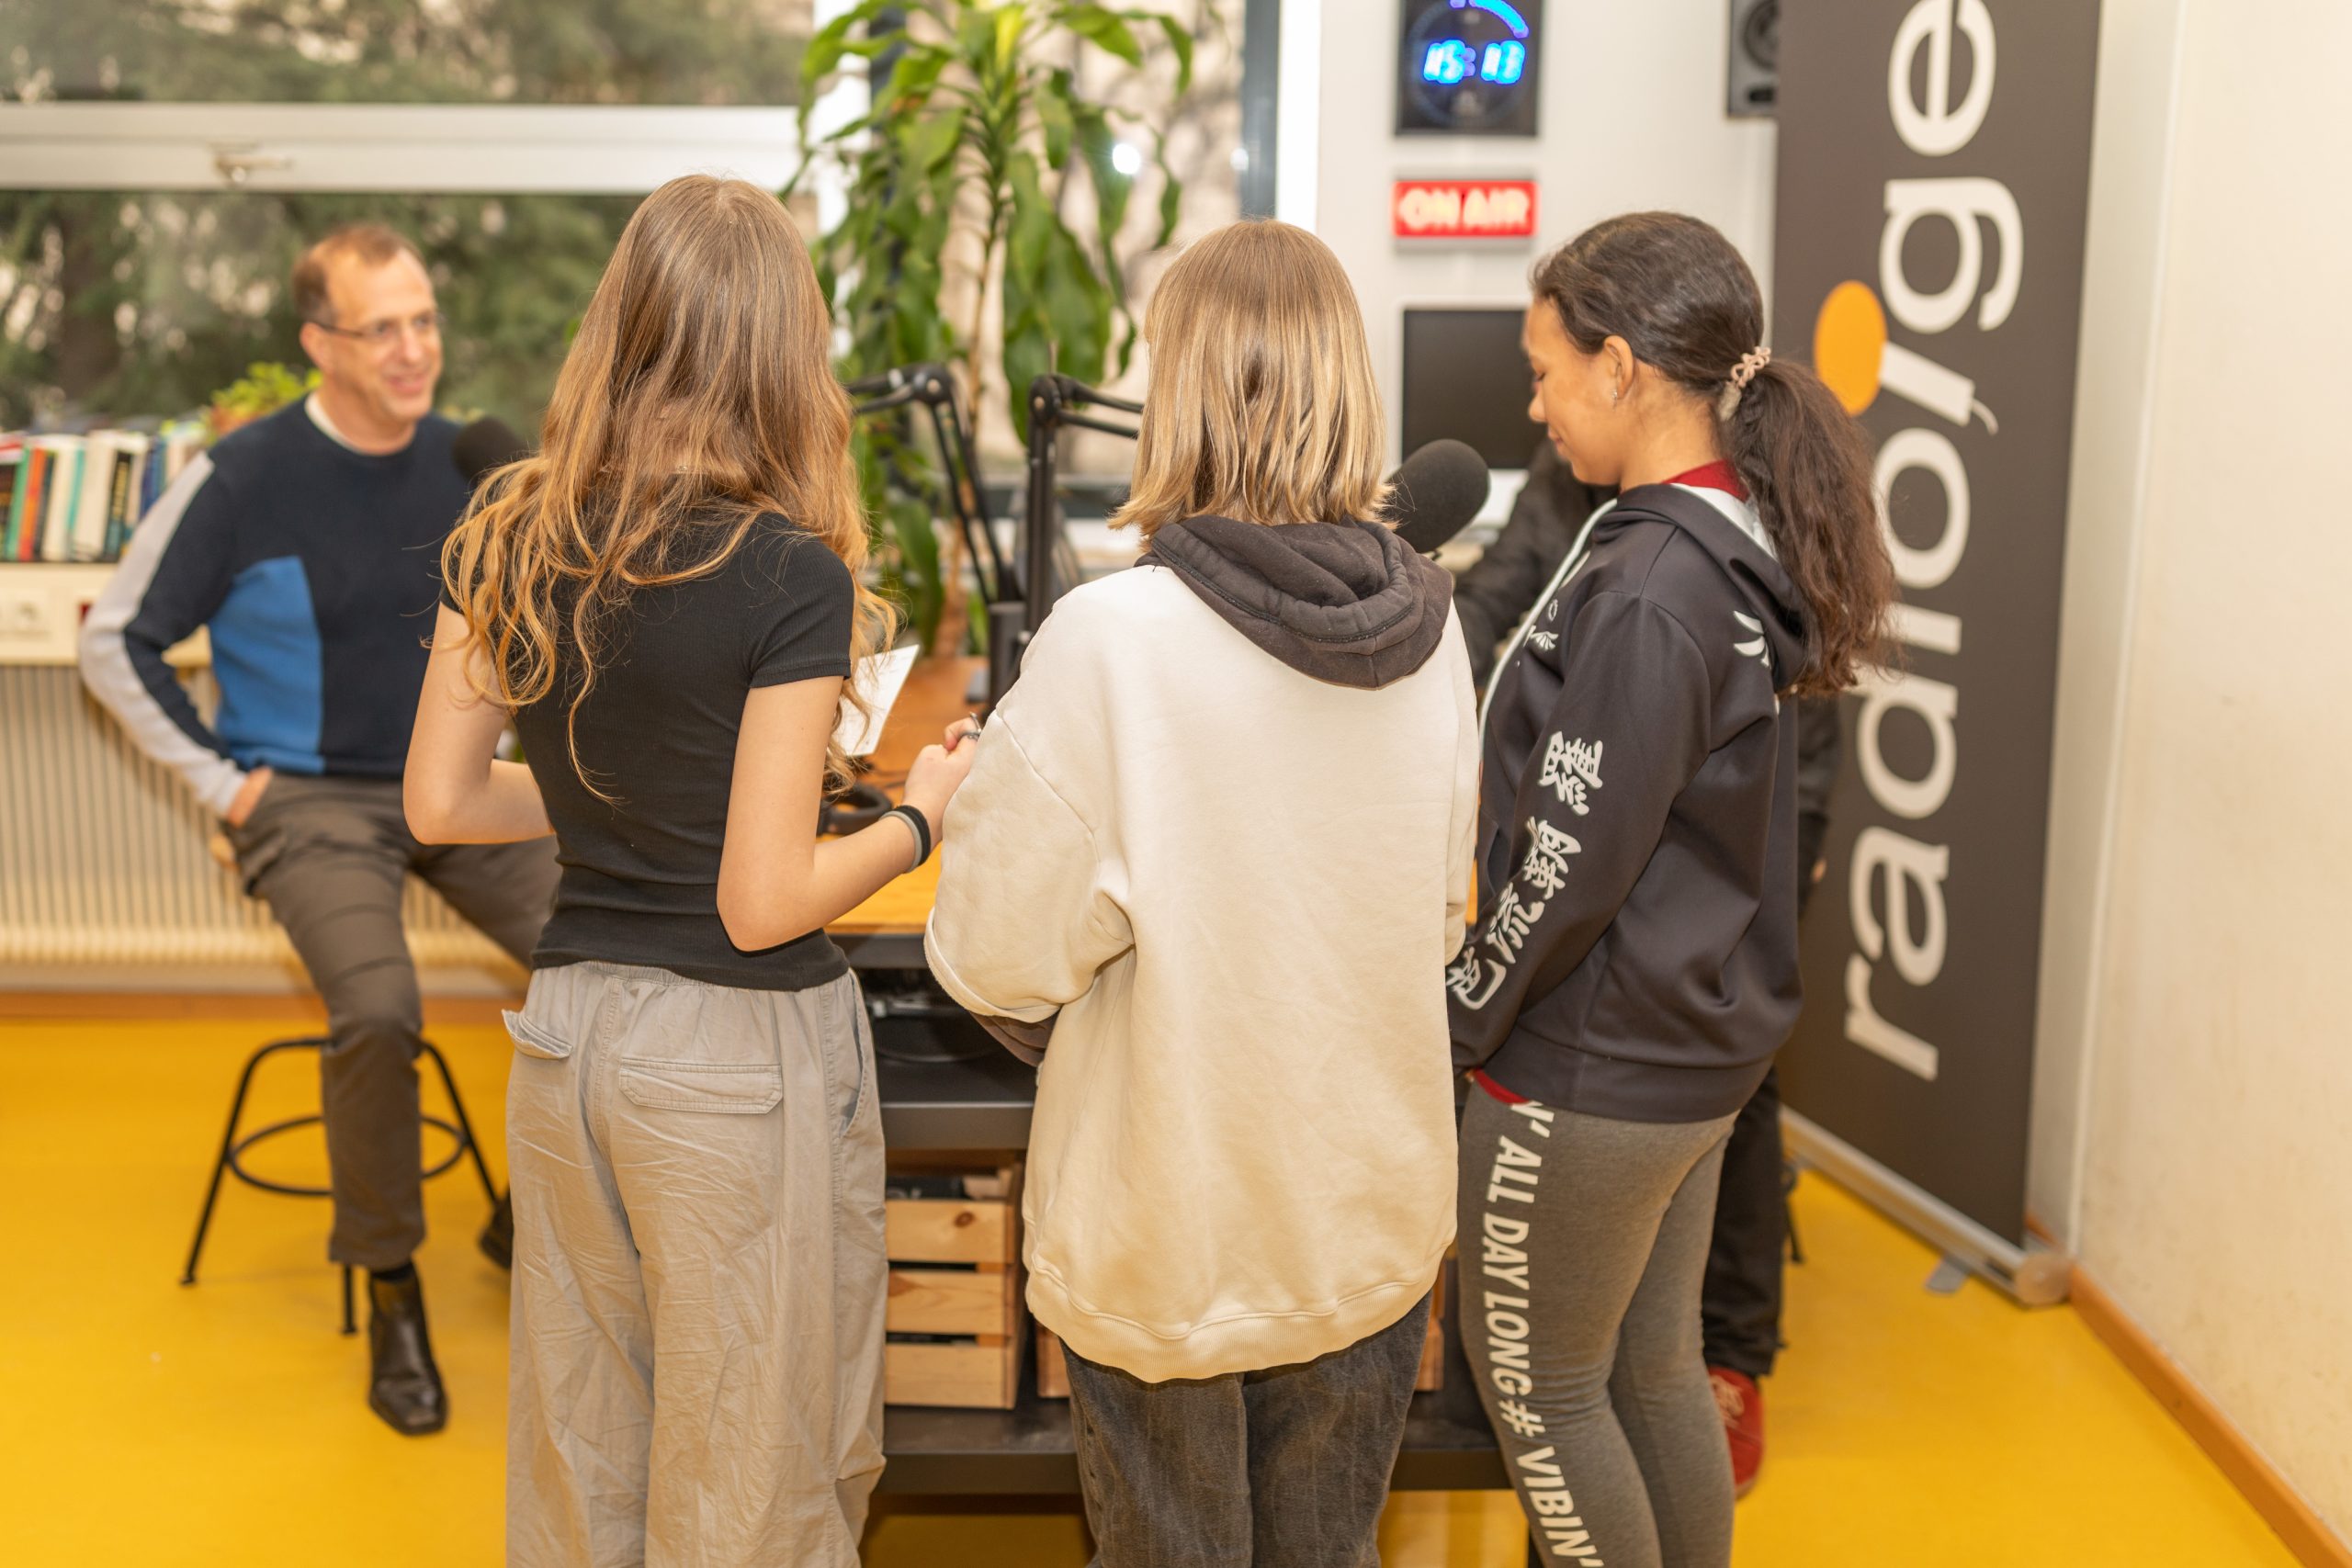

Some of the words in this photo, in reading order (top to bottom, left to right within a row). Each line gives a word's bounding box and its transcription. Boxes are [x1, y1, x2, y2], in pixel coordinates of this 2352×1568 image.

[1397, 186, 1461, 231] ON
[1463, 186, 1530, 229] AIR
[1487, 1134, 1543, 1203] ALL
[1482, 1213, 1531, 1291] DAY
